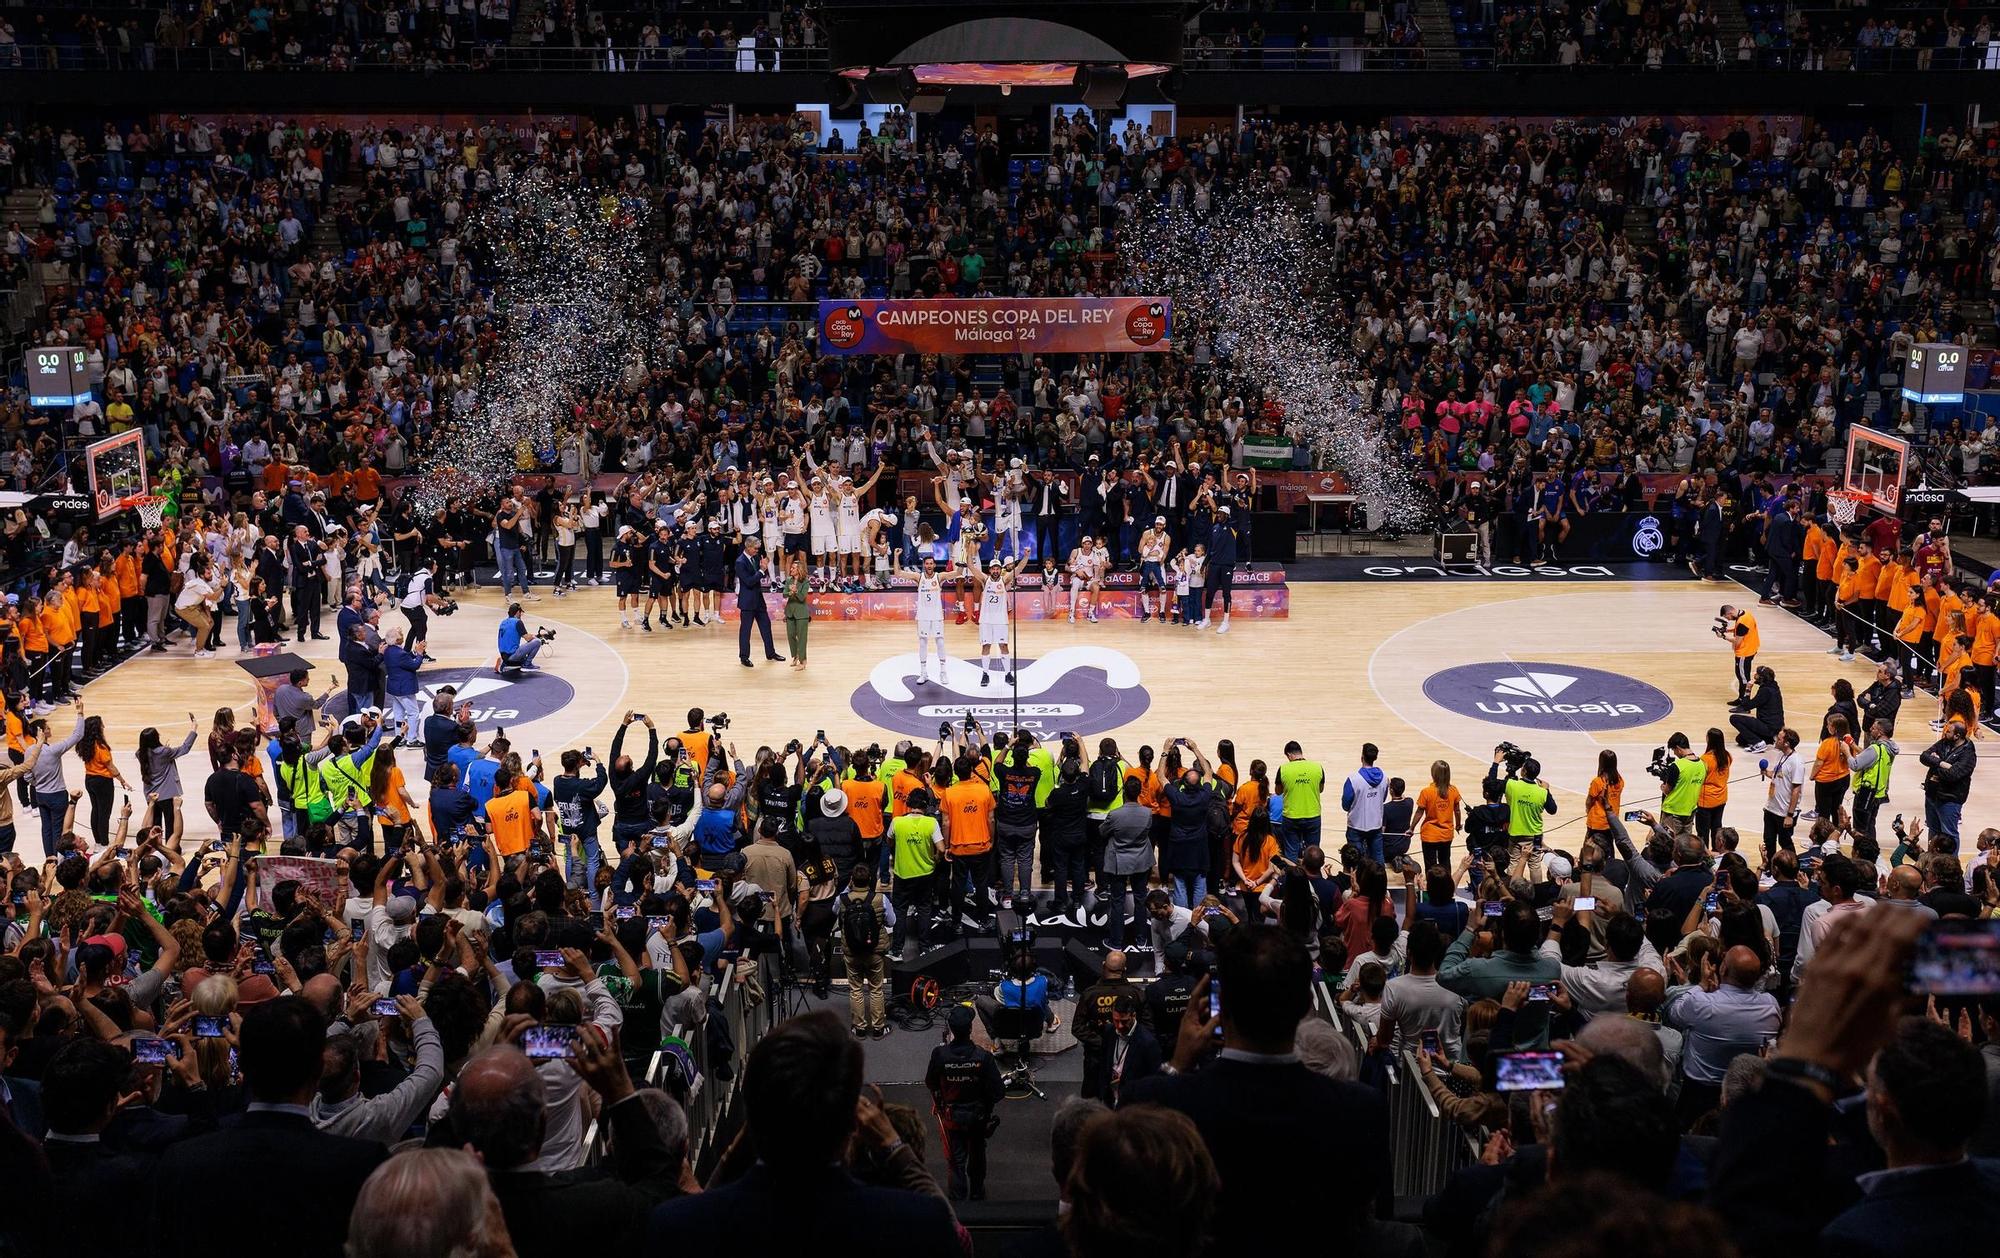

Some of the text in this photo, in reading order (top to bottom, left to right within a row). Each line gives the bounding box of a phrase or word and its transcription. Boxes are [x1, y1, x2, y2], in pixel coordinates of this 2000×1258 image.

[876, 308, 1114, 325] CAMPEONES COPA DEL REY
[831, 324, 852, 332] Copa
[1132, 321, 1152, 329] Copa
[841, 331, 855, 339] Rey
[955, 327, 1036, 342] Málaga '24
[1142, 328, 1155, 336] Rey
[38, 354, 60, 366] 0.0
[73, 351, 85, 364] 0.0
[1910, 349, 1921, 362] 0.0
[1938, 352, 1959, 364] 0.0
[1280, 483, 1308, 492] málaga
[53, 499, 90, 509] endes
[1363, 565, 1615, 576] endesa
[926, 593, 932, 602] 5
[989, 595, 999, 604] 23
[935, 705, 1062, 716] Málaga '24
[1475, 701, 1645, 717] Unicaja
[765, 798, 788, 808] TAVARES
